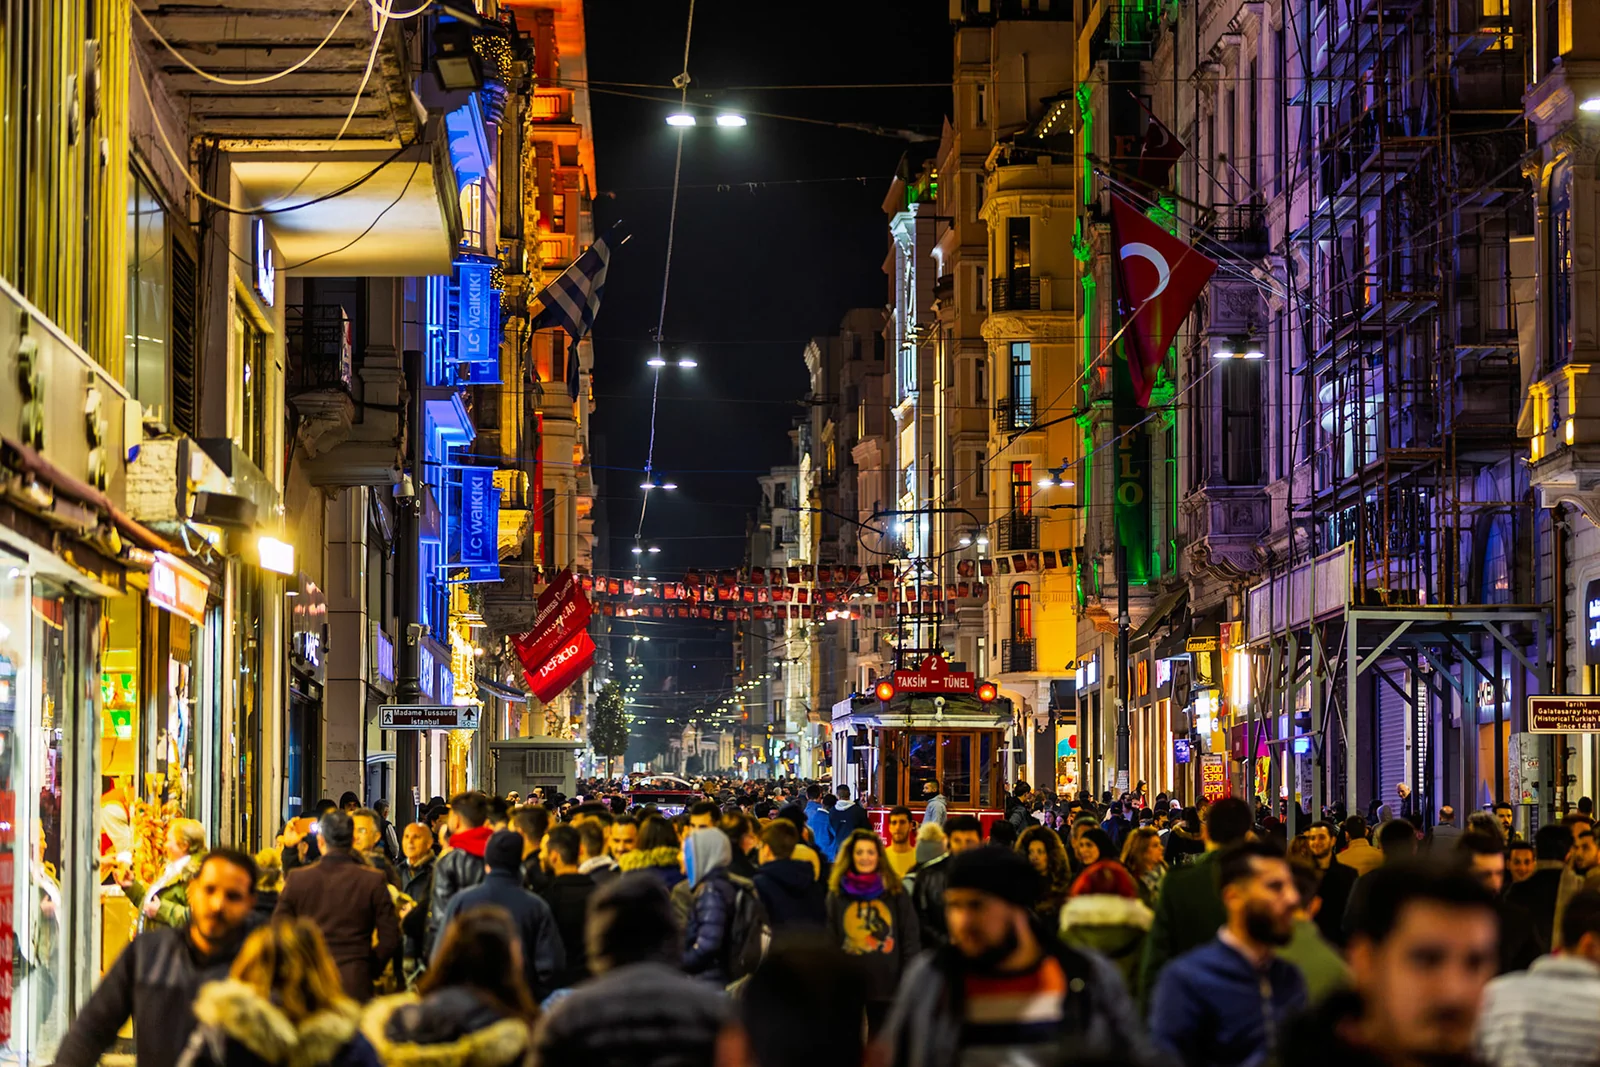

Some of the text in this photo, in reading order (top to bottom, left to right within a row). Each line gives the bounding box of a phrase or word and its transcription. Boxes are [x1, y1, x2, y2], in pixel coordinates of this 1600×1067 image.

[468, 333, 480, 353] LC
[1117, 425, 1143, 507] FLO
[470, 538, 482, 557] LC
[539, 643, 579, 678] DeFacto
[931, 657, 937, 670] 2
[897, 674, 927, 687] TAKSİM
[943, 674, 969, 688] TÜNEL
[411, 717, 440, 725] İstanbul
